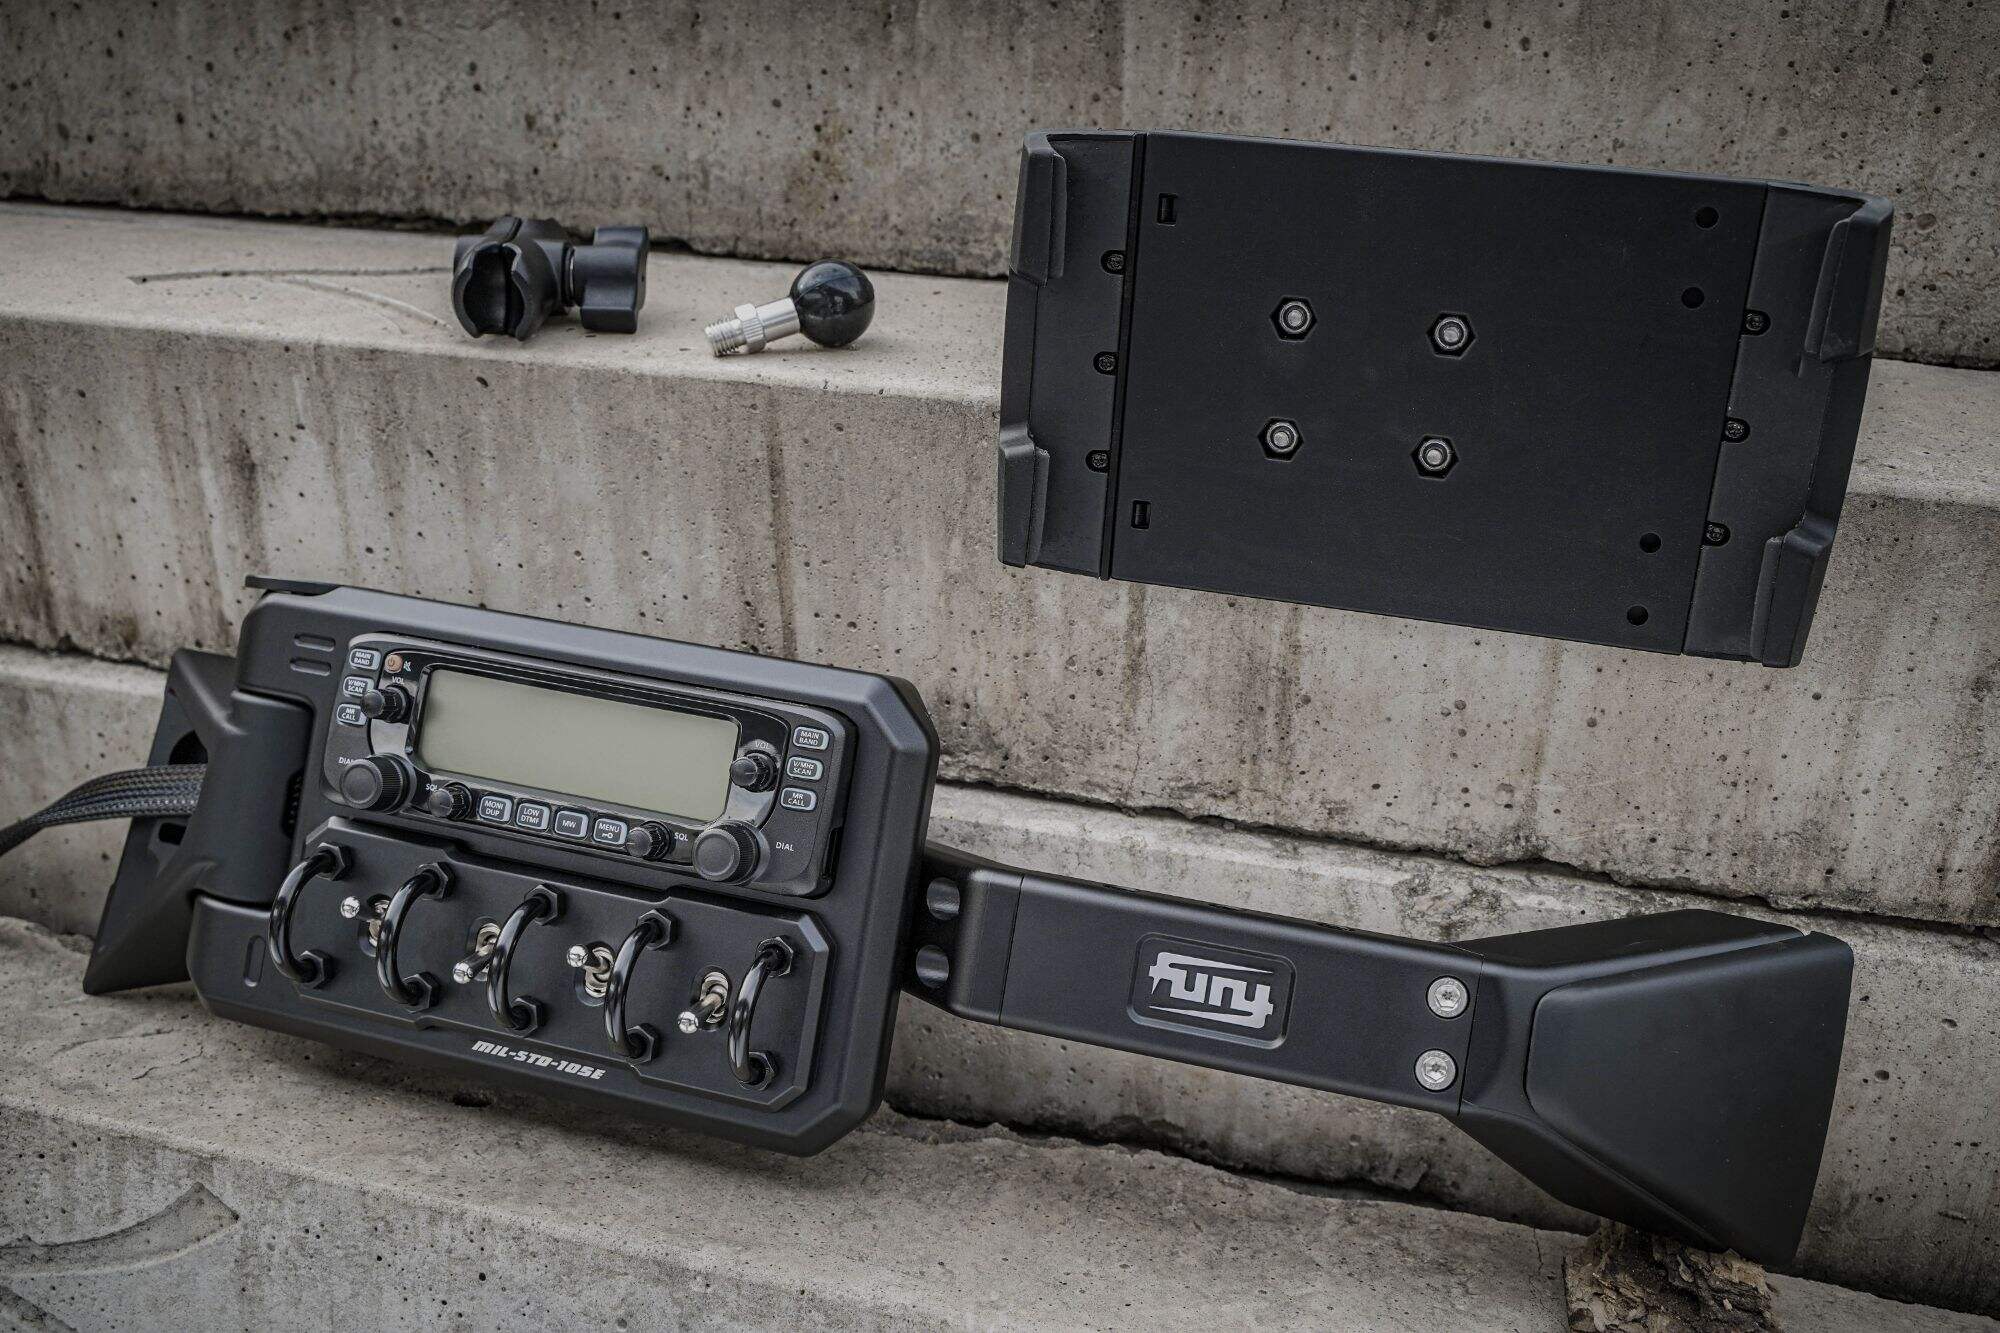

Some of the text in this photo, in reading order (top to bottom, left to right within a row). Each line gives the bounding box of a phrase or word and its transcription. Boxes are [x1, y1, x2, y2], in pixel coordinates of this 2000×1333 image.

[354, 651, 372, 660] MAIN
[353, 658, 370, 666] BAND
[392, 676, 405, 685] VOL
[347, 686, 364, 694] SCAN
[341, 713, 356, 721] CALL
[799, 730, 820, 739] MAIN
[755, 741, 770, 750] VOL
[799, 737, 819, 746] BAND
[792, 768, 813, 776] SCAN
[792, 792, 804, 800] MR
[484, 800, 504, 810] MONI
[787, 798, 805, 807] CALL
[485, 808, 501, 817] DUP
[523, 807, 541, 816] LOW
[520, 814, 540, 825] DTMF
[562, 819, 576, 829] MW
[598, 822, 620, 833] MENU
[674, 832, 688, 842] SQL
[775, 842, 794, 852] DIAL
